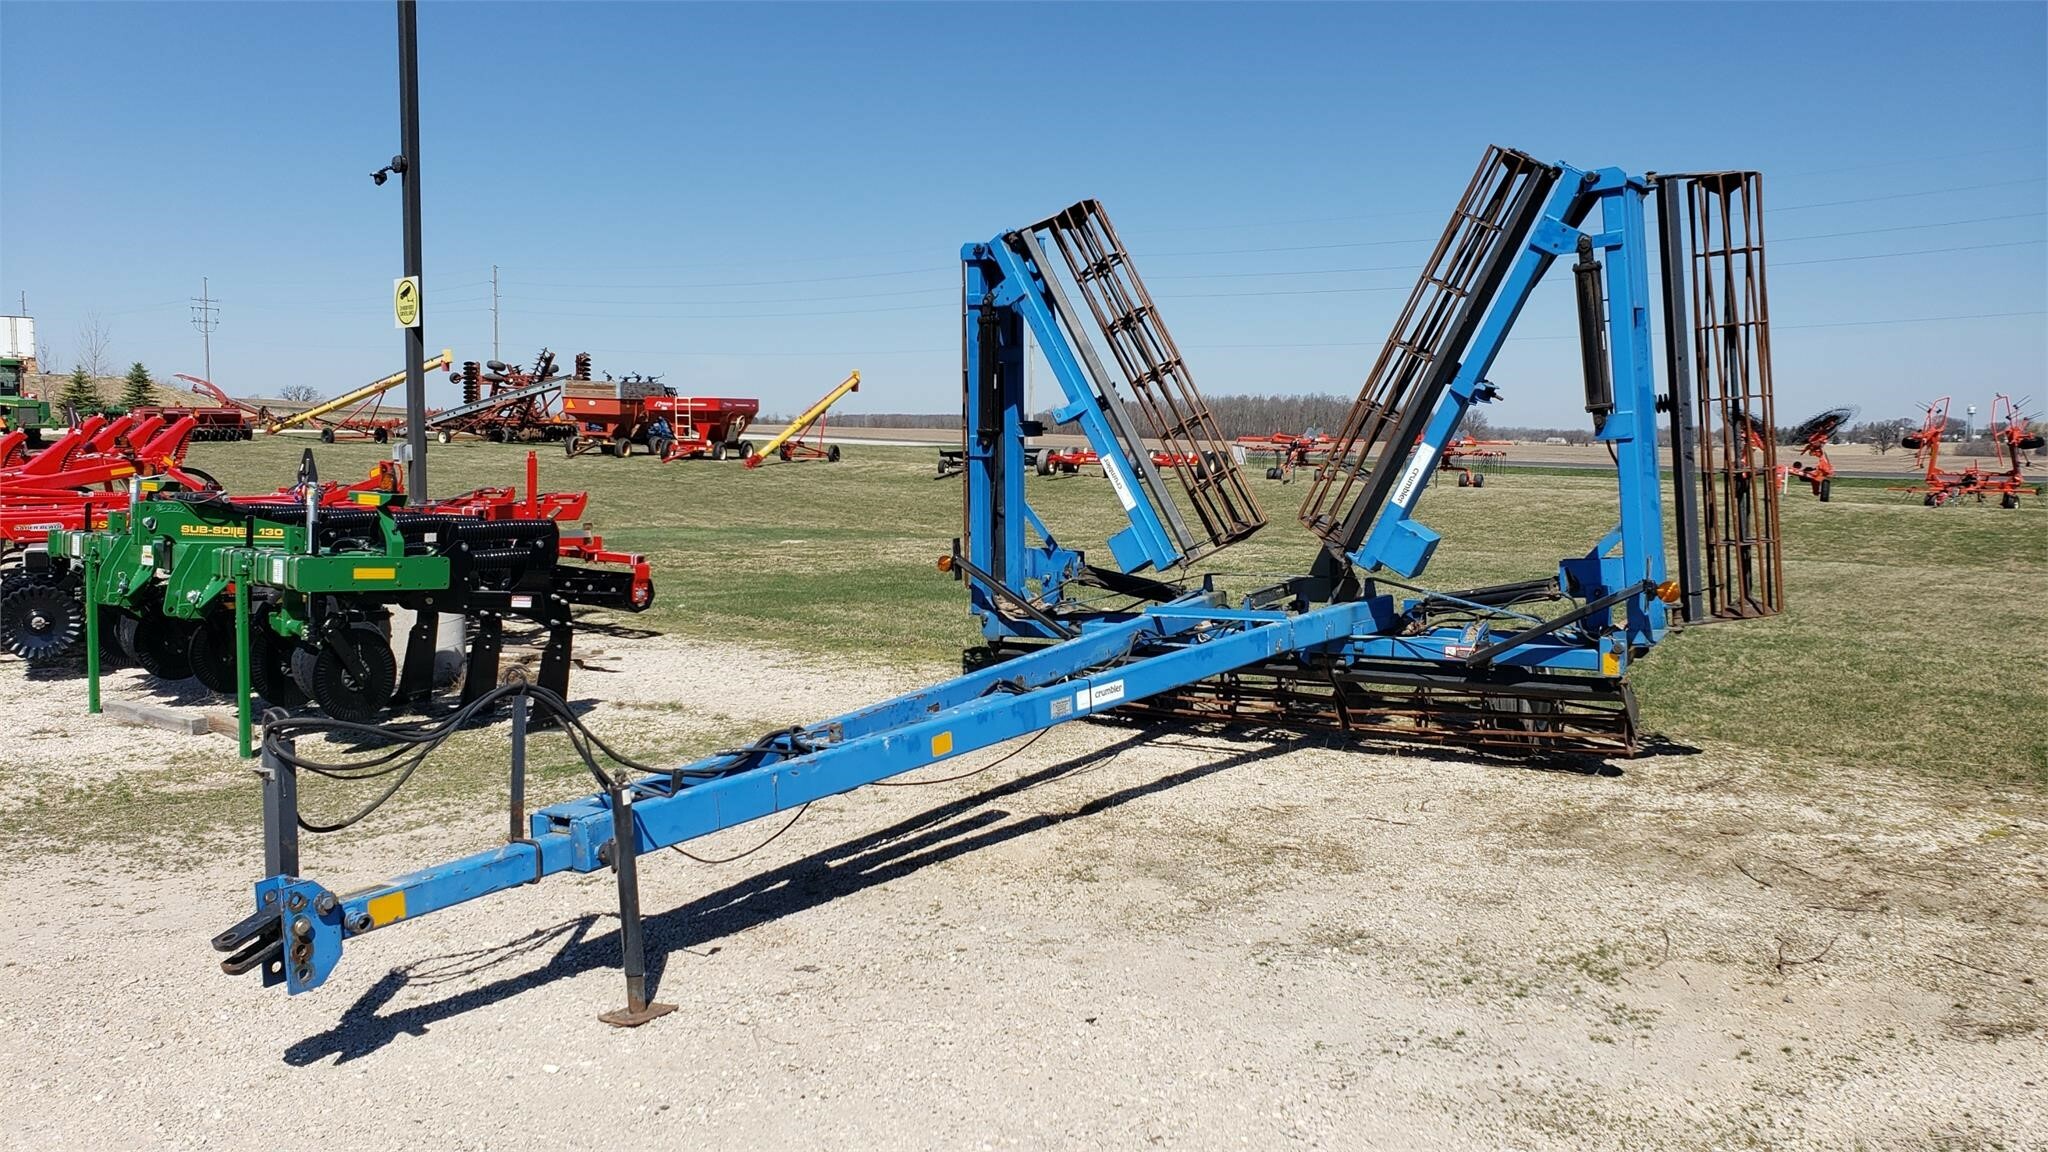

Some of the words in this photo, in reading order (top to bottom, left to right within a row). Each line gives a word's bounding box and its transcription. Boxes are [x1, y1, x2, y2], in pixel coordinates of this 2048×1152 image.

[1397, 467, 1420, 504] crumbler
[258, 528, 284, 536] 130
[1094, 683, 1123, 699] crumbler
